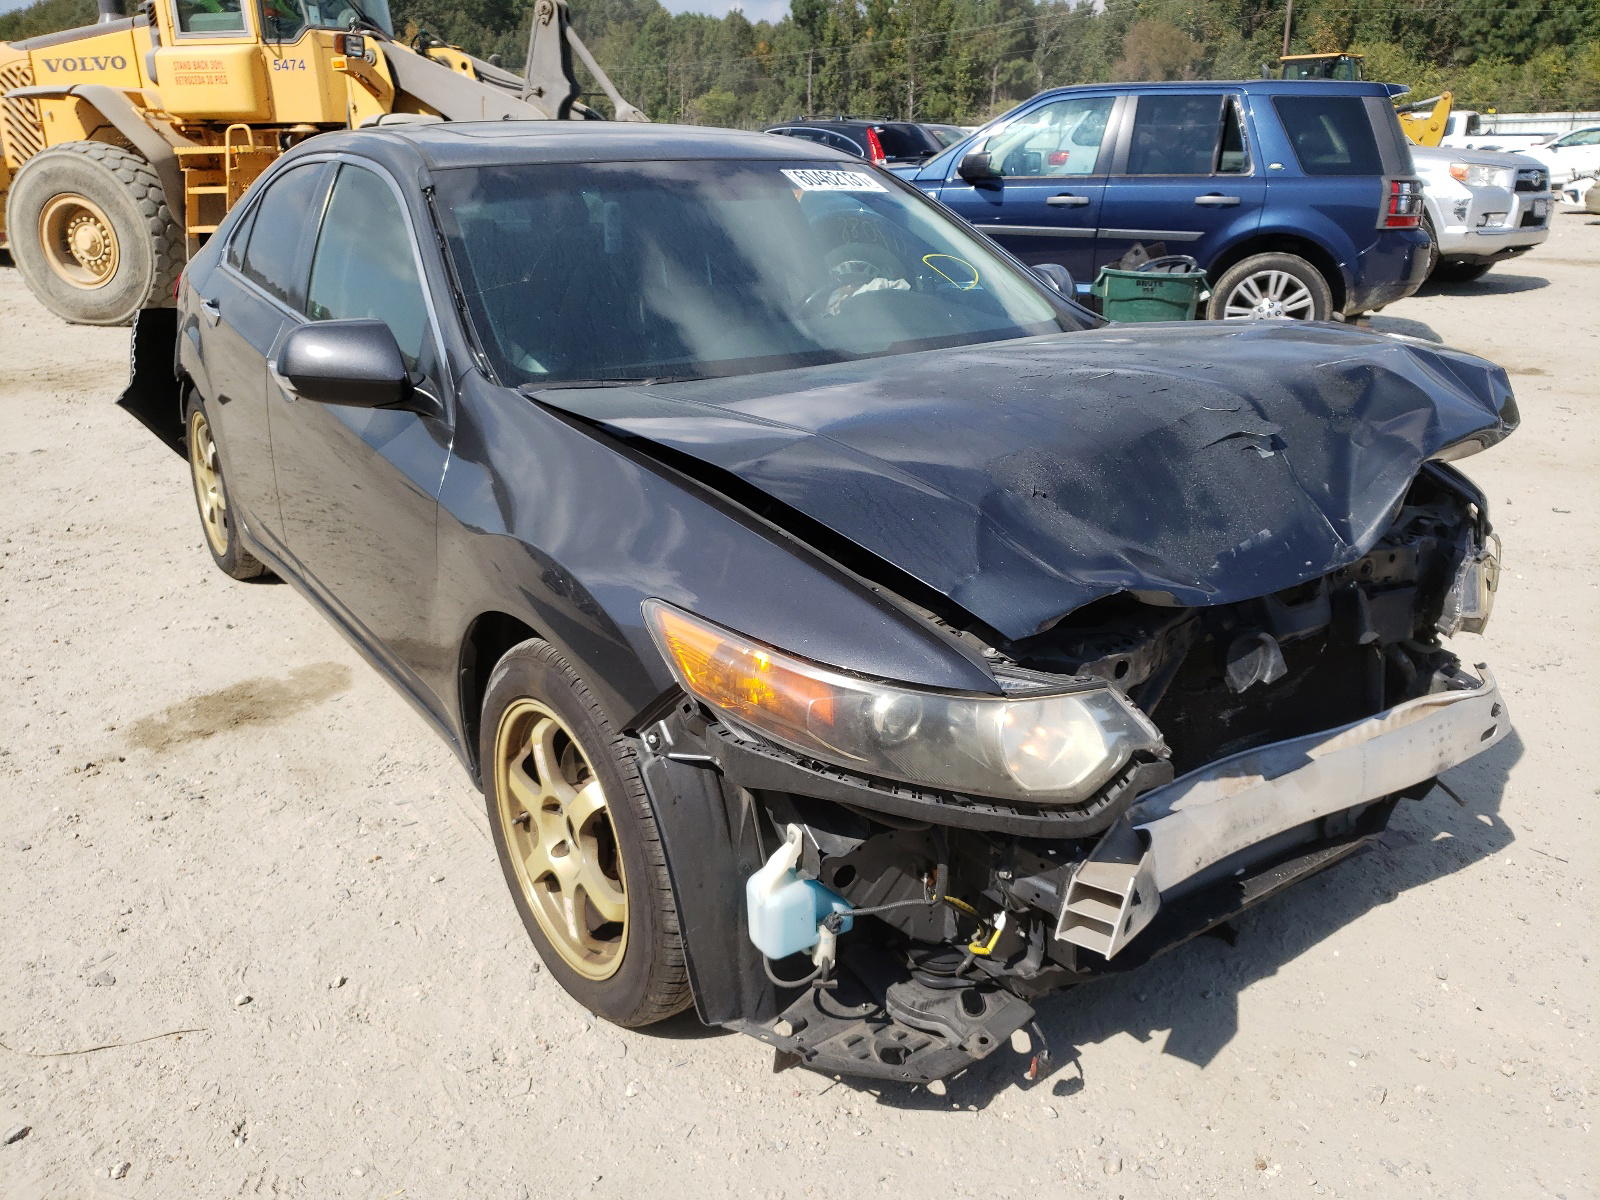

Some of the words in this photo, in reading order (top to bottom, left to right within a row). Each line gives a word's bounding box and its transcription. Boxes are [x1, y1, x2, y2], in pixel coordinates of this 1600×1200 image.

[41, 55, 127, 73] VOLVO
[272, 59, 306, 71] 5474
[792, 170, 869, 187] 60462131
